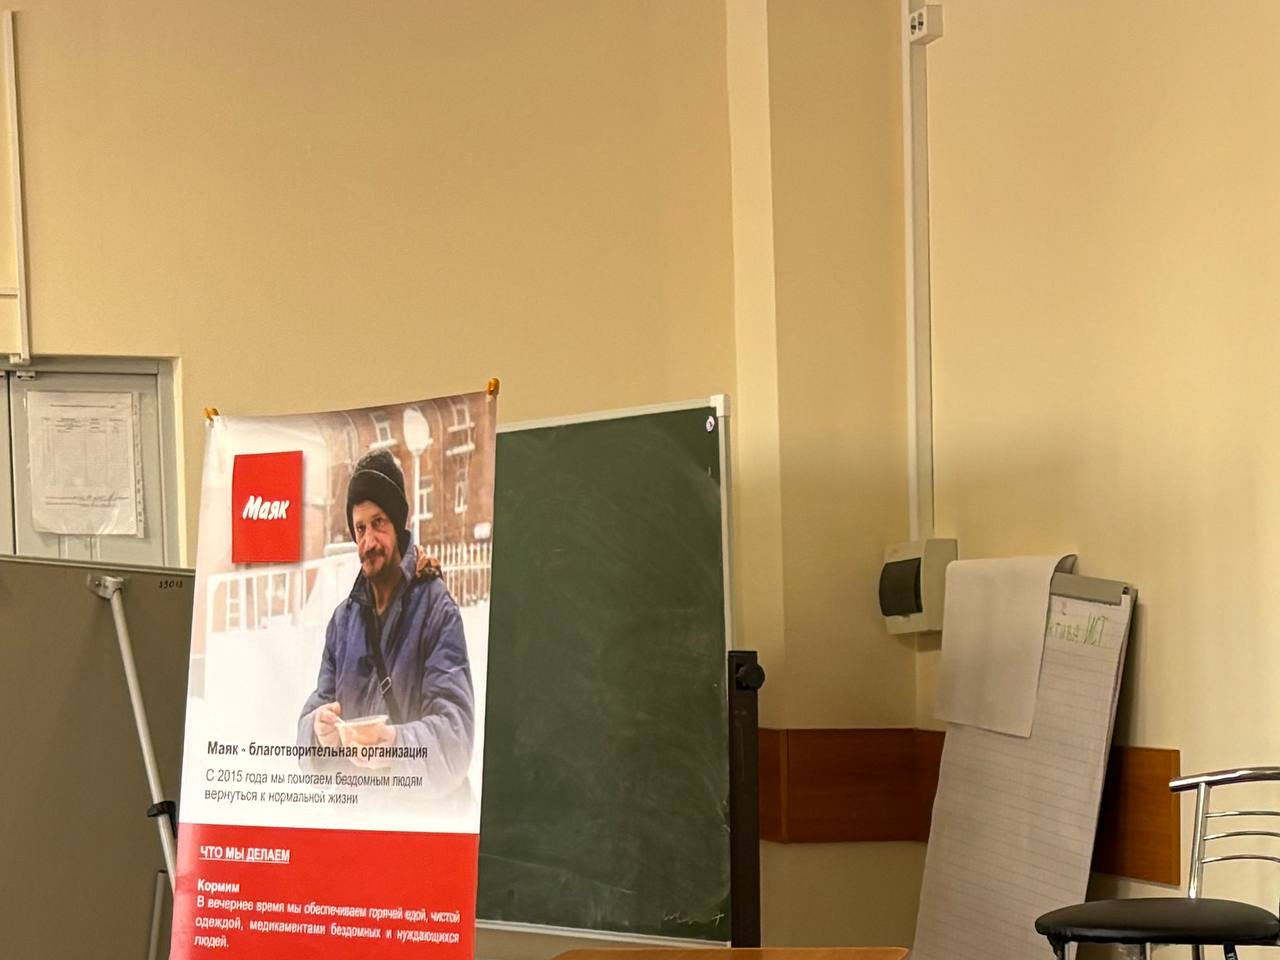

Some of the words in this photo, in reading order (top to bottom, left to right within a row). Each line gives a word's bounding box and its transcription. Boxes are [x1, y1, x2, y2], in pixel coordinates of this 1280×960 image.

[242, 496, 290, 521] Маяк
[208, 741, 239, 755] Маяк
[249, 742, 358, 760] благотворительная
[361, 746, 428, 761] организация
[206, 769, 214, 781] С
[217, 769, 243, 783] 2015
[245, 772, 268, 784] года
[271, 773, 285, 784] мы
[287, 773, 333, 785] помогаем
[335, 772, 390, 787] бездомным
[392, 776, 423, 788] людям
[204, 790, 257, 803] вернуться
[260, 791, 266, 801] к
[268, 791, 326, 804] нормальной
[328, 793, 358, 804] жизни
[200, 846, 223, 858] ЧТО
[225, 847, 245, 859] МЫ
[246, 848, 290, 862] ДЕЛАЕМ
[197, 879, 240, 893] Кормим
[197, 895, 205, 908] В
[208, 898, 253, 911] вечернее
[256, 901, 285, 914] время
[287, 902, 302, 914] мы
[304, 902, 367, 917] обеспечиваем
[368, 907, 403, 920] горячей
[431, 910, 460, 923] чистой
[195, 917, 244, 931] одеждой,
[249, 920, 326, 935] медикаментами
[330, 923, 381, 938] бездомных
[386, 929, 392, 939] и
[397, 929, 460, 944] нуждающихся
[194, 935, 229, 949] людей.
